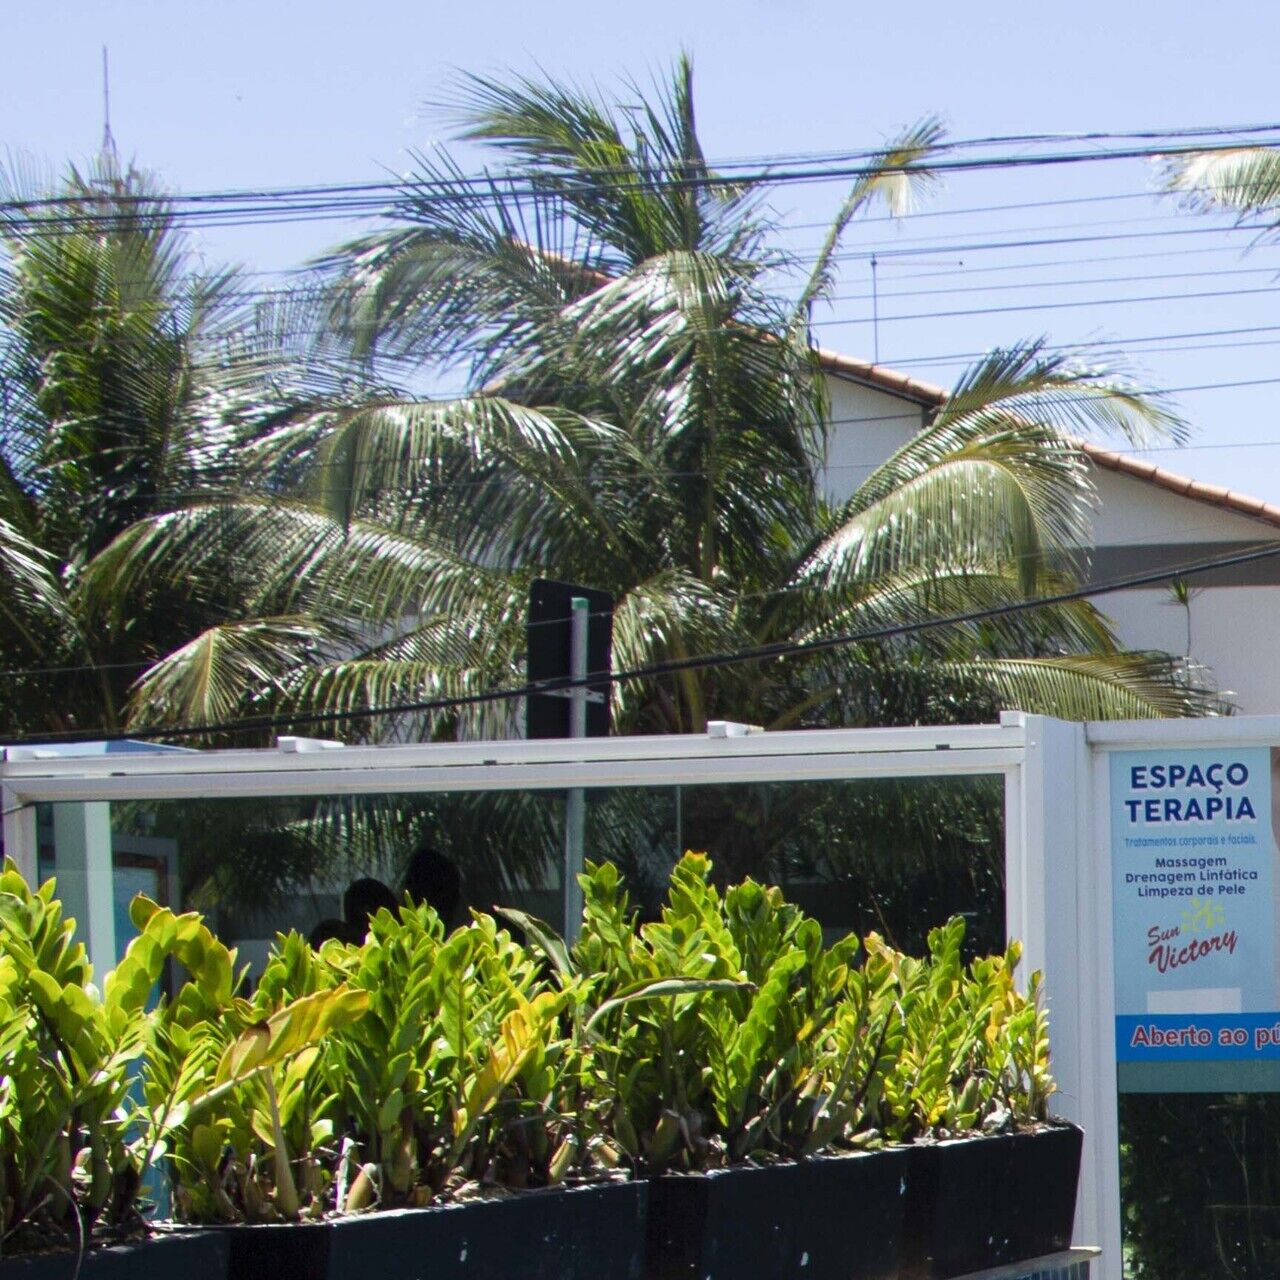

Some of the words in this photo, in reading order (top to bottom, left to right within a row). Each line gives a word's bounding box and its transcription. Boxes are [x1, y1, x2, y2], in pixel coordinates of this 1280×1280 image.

[1131, 762, 1248, 794] ESPAÇO
[1125, 796, 1256, 822] TERAPIA
[1125, 836, 1176, 848] Tratamentos
[1179, 835, 1218, 848] corporais
[1221, 836, 1225, 844] e
[1156, 857, 1226, 869] Massagem
[1126, 872, 1196, 884] Drenagem
[1138, 885, 1193, 898] Limpeza
[1197, 885, 1214, 896] de
[1218, 885, 1246, 894] Pele
[1148, 926, 1180, 946] Sun
[1148, 930, 1238, 973] Victory
[1131, 1025, 1212, 1047] Aberto
[1218, 1025, 1249, 1045] ao
